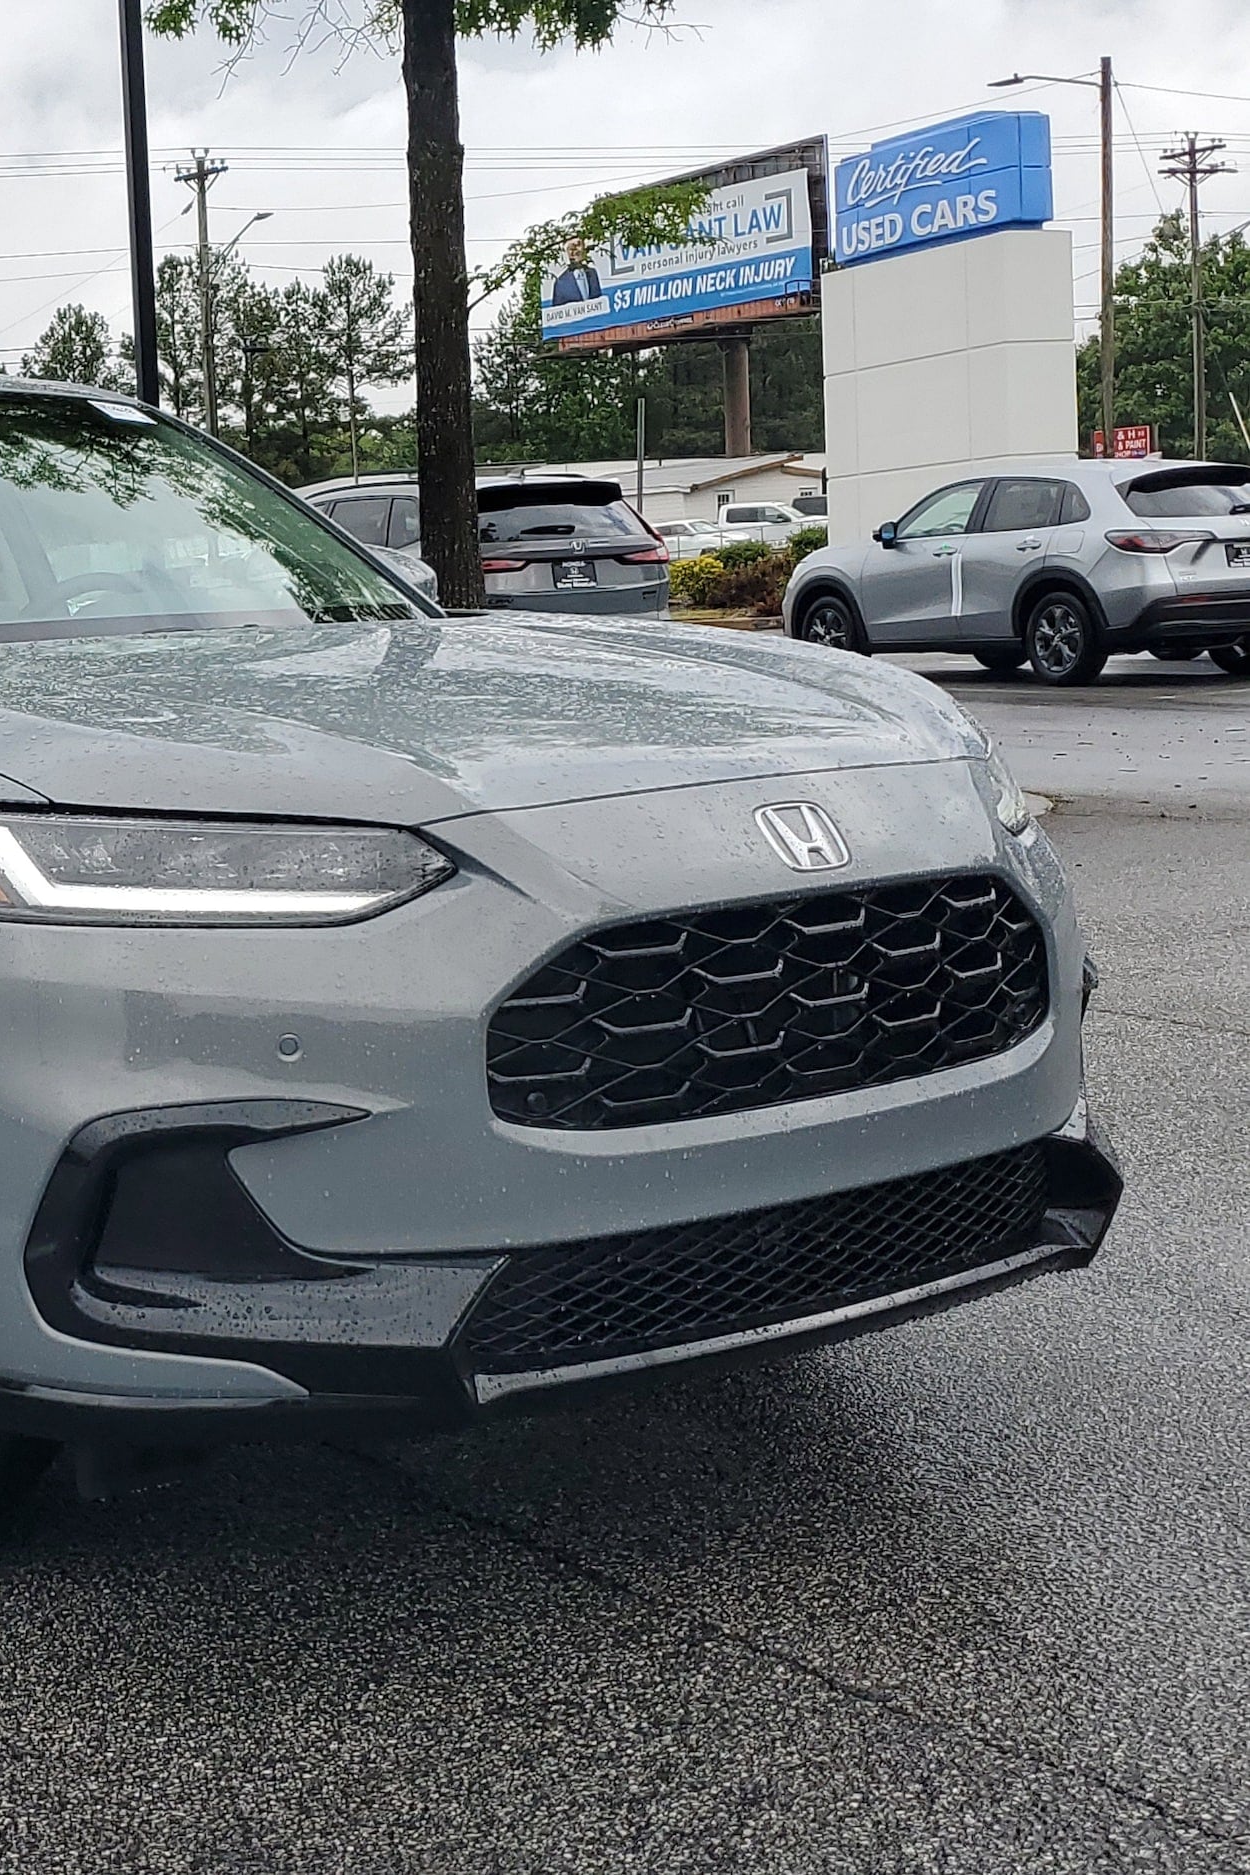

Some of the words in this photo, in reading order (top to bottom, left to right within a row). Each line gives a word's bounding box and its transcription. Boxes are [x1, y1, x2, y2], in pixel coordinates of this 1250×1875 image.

[847, 138, 987, 207] Certified
[726, 194, 744, 209] call
[733, 203, 782, 238] LAW
[842, 213, 903, 255] USED
[910, 190, 997, 236] CARS
[640, 253, 683, 274] personal
[685, 249, 715, 267] injury
[717, 239, 758, 258] lawyers
[613, 290, 630, 313] $3
[634, 279, 692, 306] MILLION
[695, 269, 736, 295] NECK
[738, 256, 796, 285] INJURY
[546, 311, 564, 322] DAVID
[573, 304, 586, 315] VAN
[586, 301, 603, 312] SANT
[1125, 438, 1147, 449] PAINT
